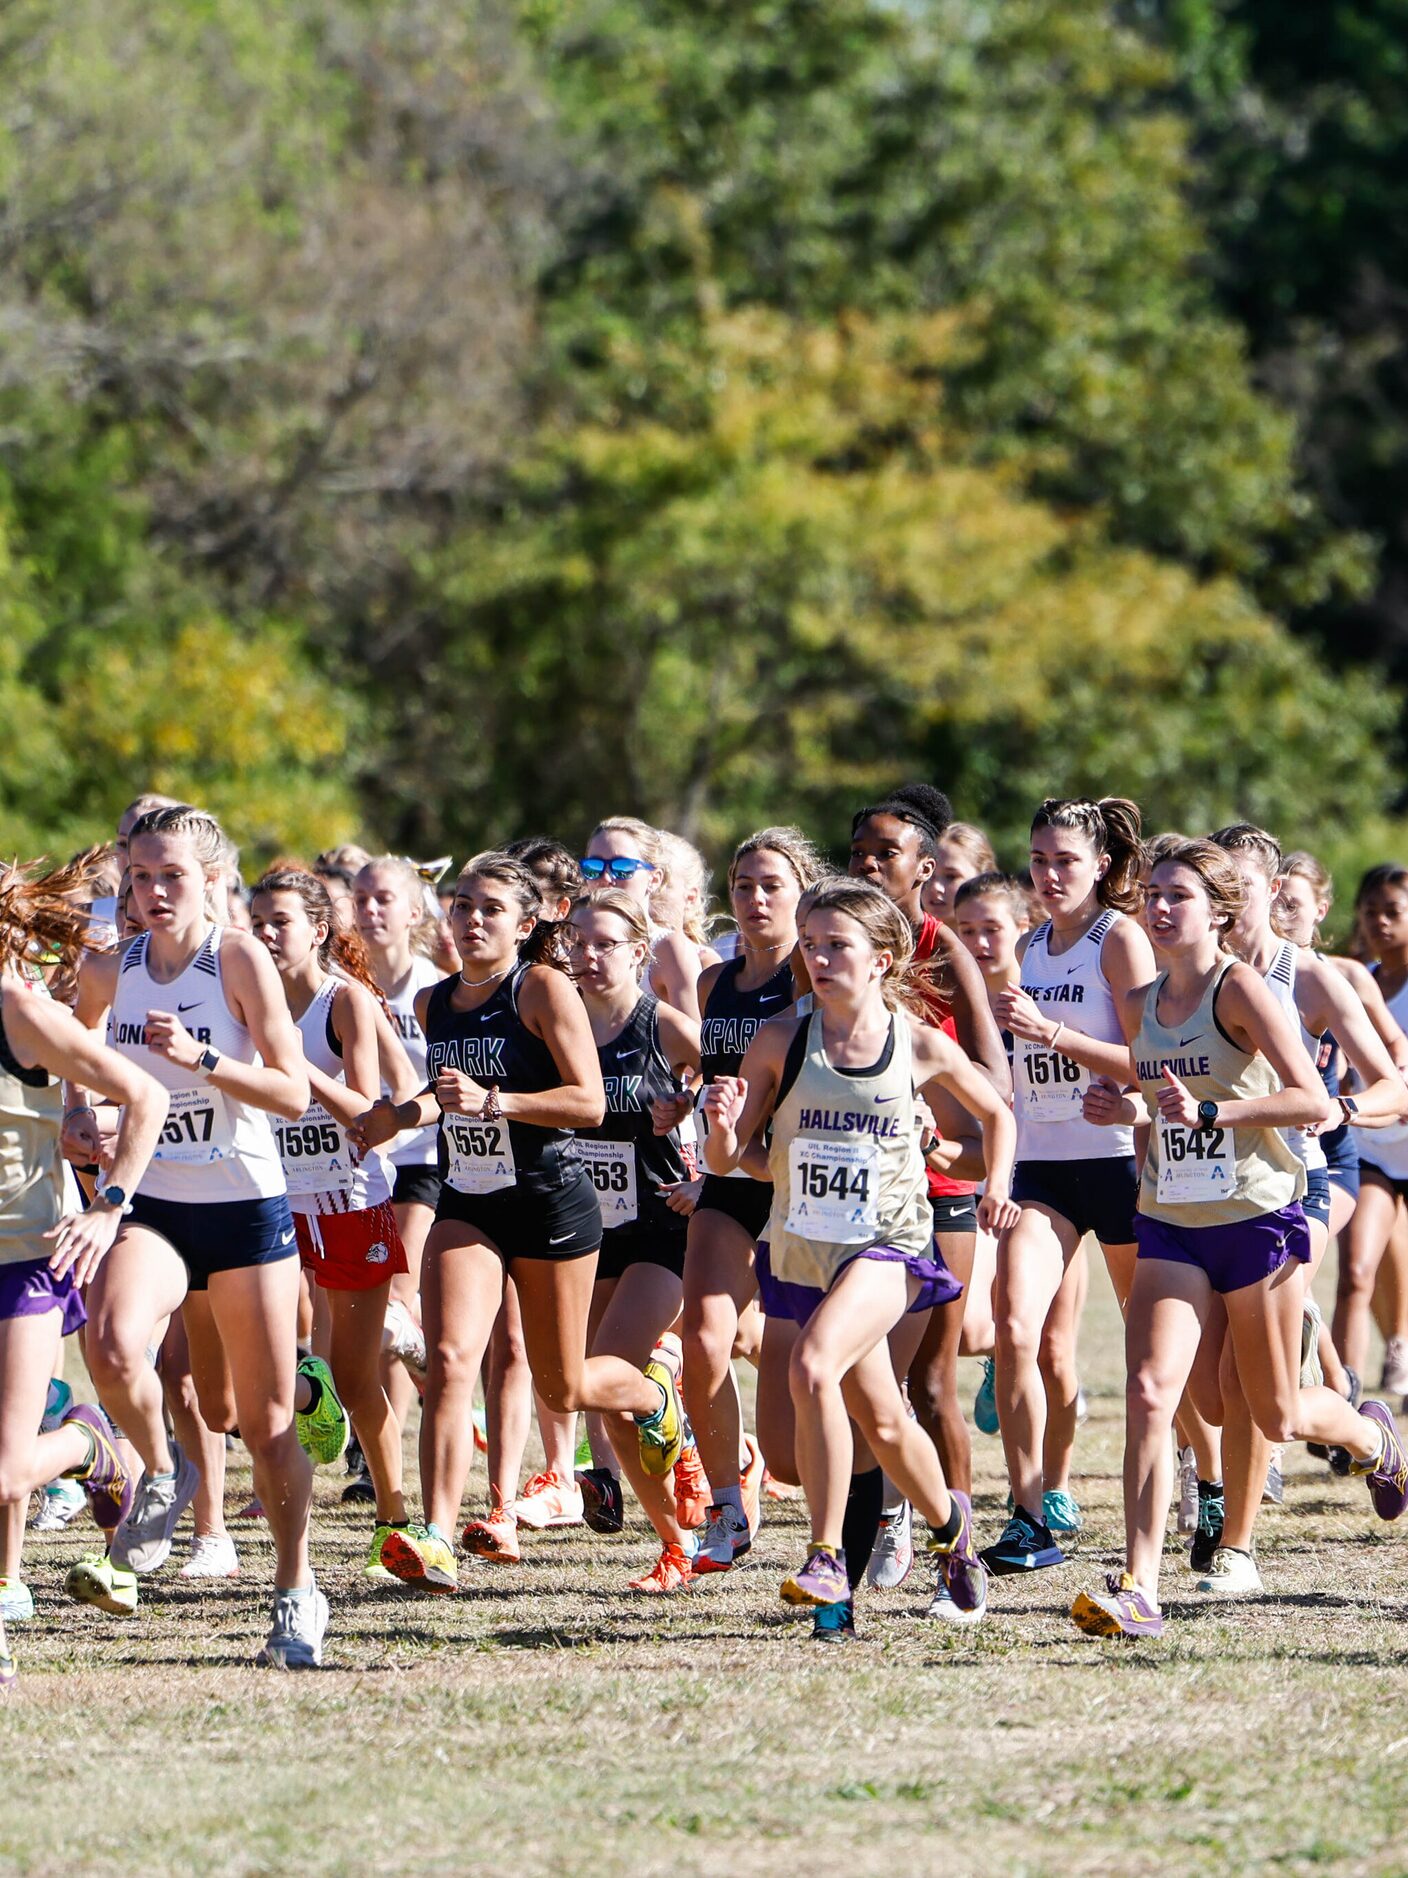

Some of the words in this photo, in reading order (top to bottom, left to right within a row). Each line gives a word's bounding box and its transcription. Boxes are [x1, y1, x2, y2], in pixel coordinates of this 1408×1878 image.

[1043, 984, 1085, 1003] STAR
[1024, 1052, 1081, 1085] 1518
[799, 1109, 899, 1138] HALLSVILLE
[275, 1123, 341, 1158] 1595
[447, 1124, 506, 1157] 1552
[585, 1142, 609, 1150] Region
[823, 1144, 852, 1153] Region
[1161, 1127, 1226, 1162] 1542
[812, 1152, 868, 1164] Championship
[797, 1162, 870, 1202] 1544
